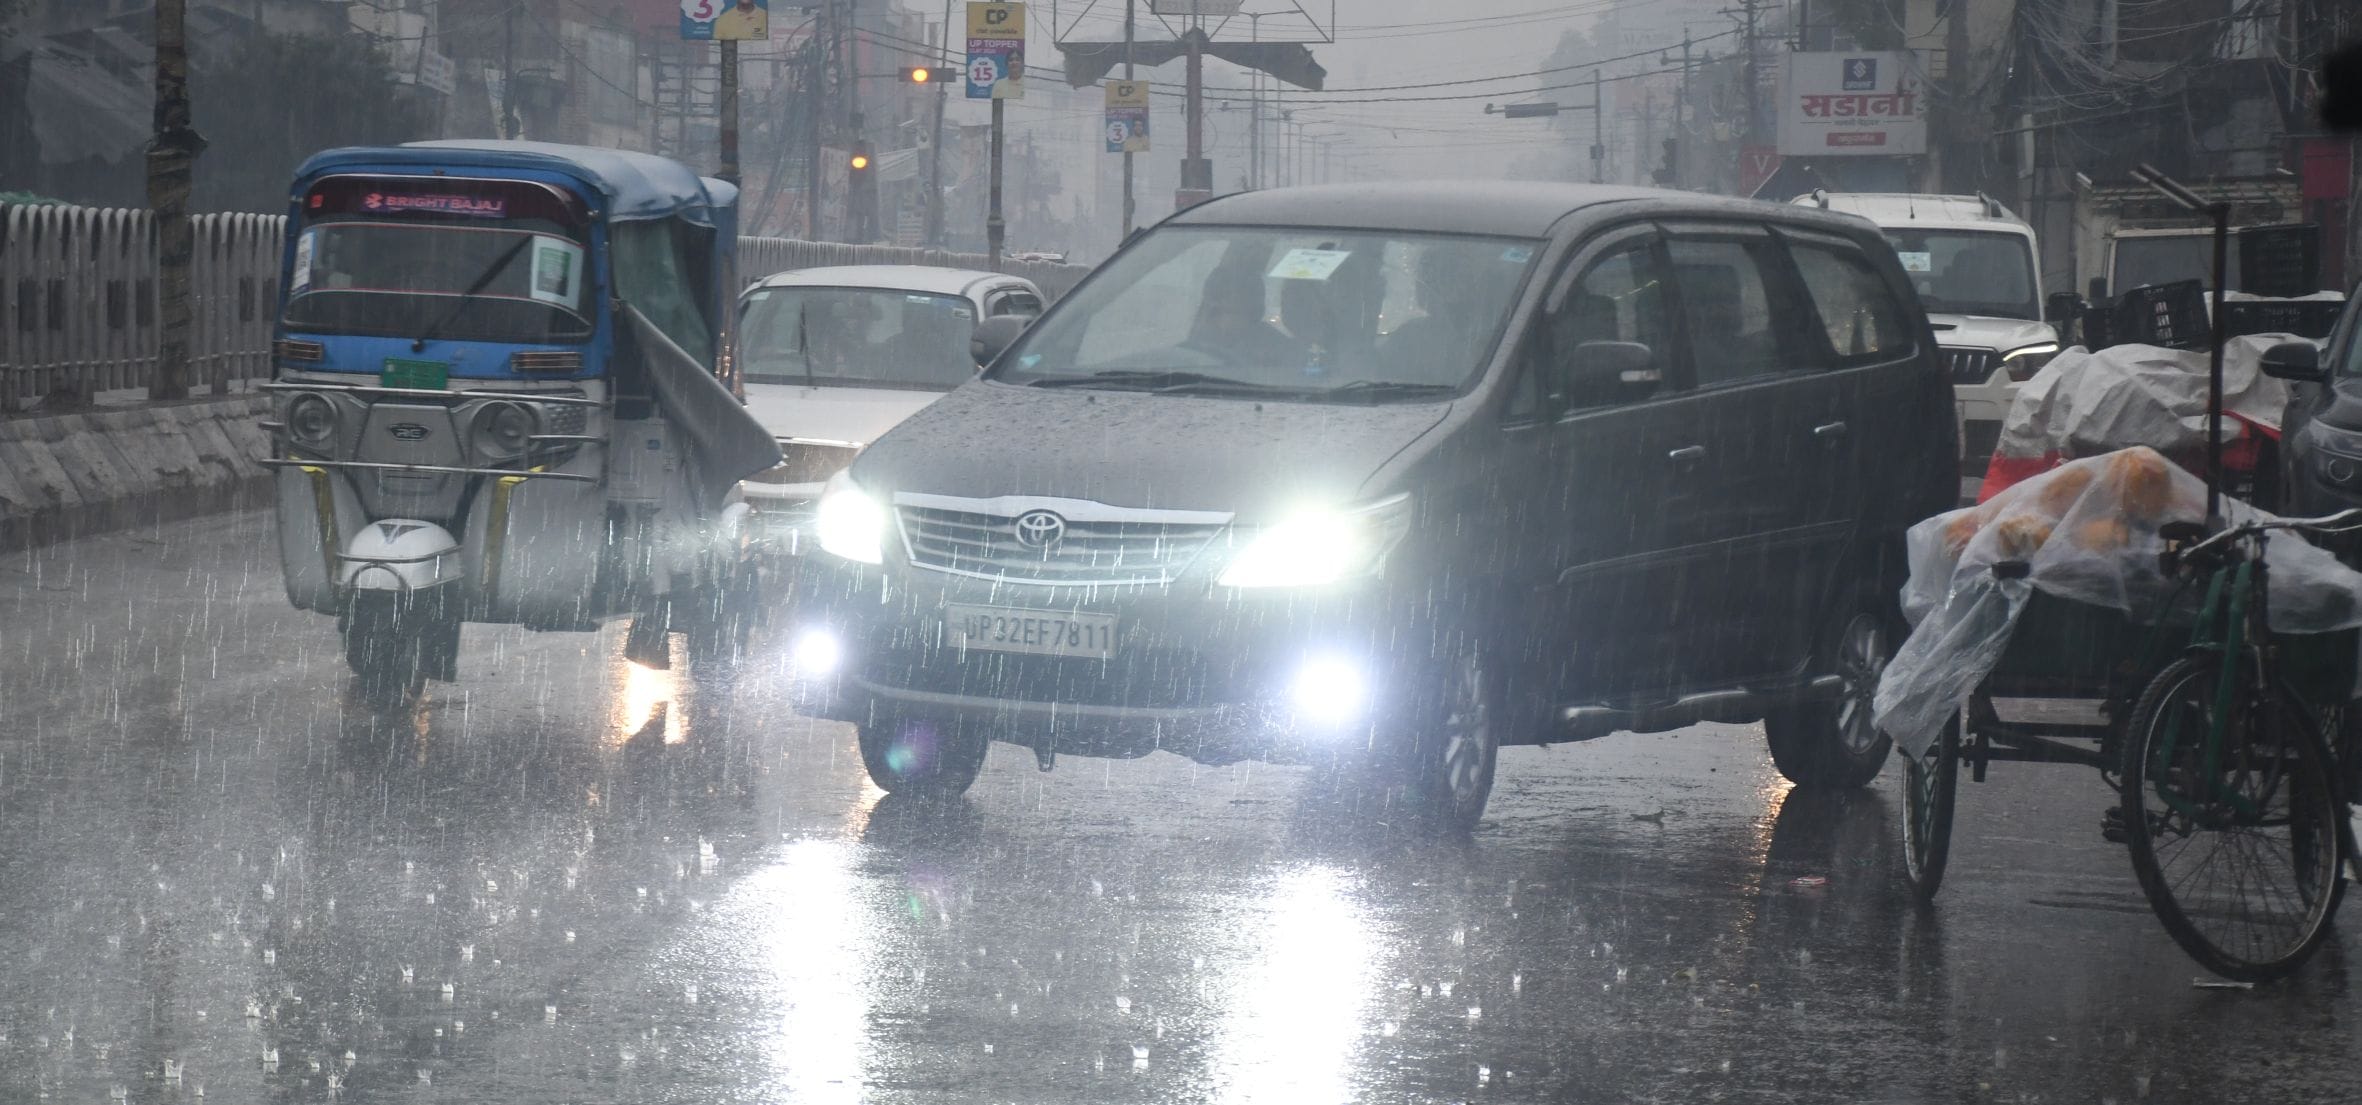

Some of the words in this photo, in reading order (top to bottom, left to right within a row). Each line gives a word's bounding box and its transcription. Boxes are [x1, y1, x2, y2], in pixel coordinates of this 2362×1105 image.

[693, 0, 713, 19] 3
[986, 9, 1008, 25] CP
[969, 39, 982, 48] UP
[983, 39, 1018, 48] TOPPER
[974, 67, 993, 81] 15
[1112, 128, 1123, 142] 3
[385, 195, 447, 208] BRIGHT
[451, 198, 502, 211] BAJAJ
[964, 614, 1109, 649] UP32EF7811
